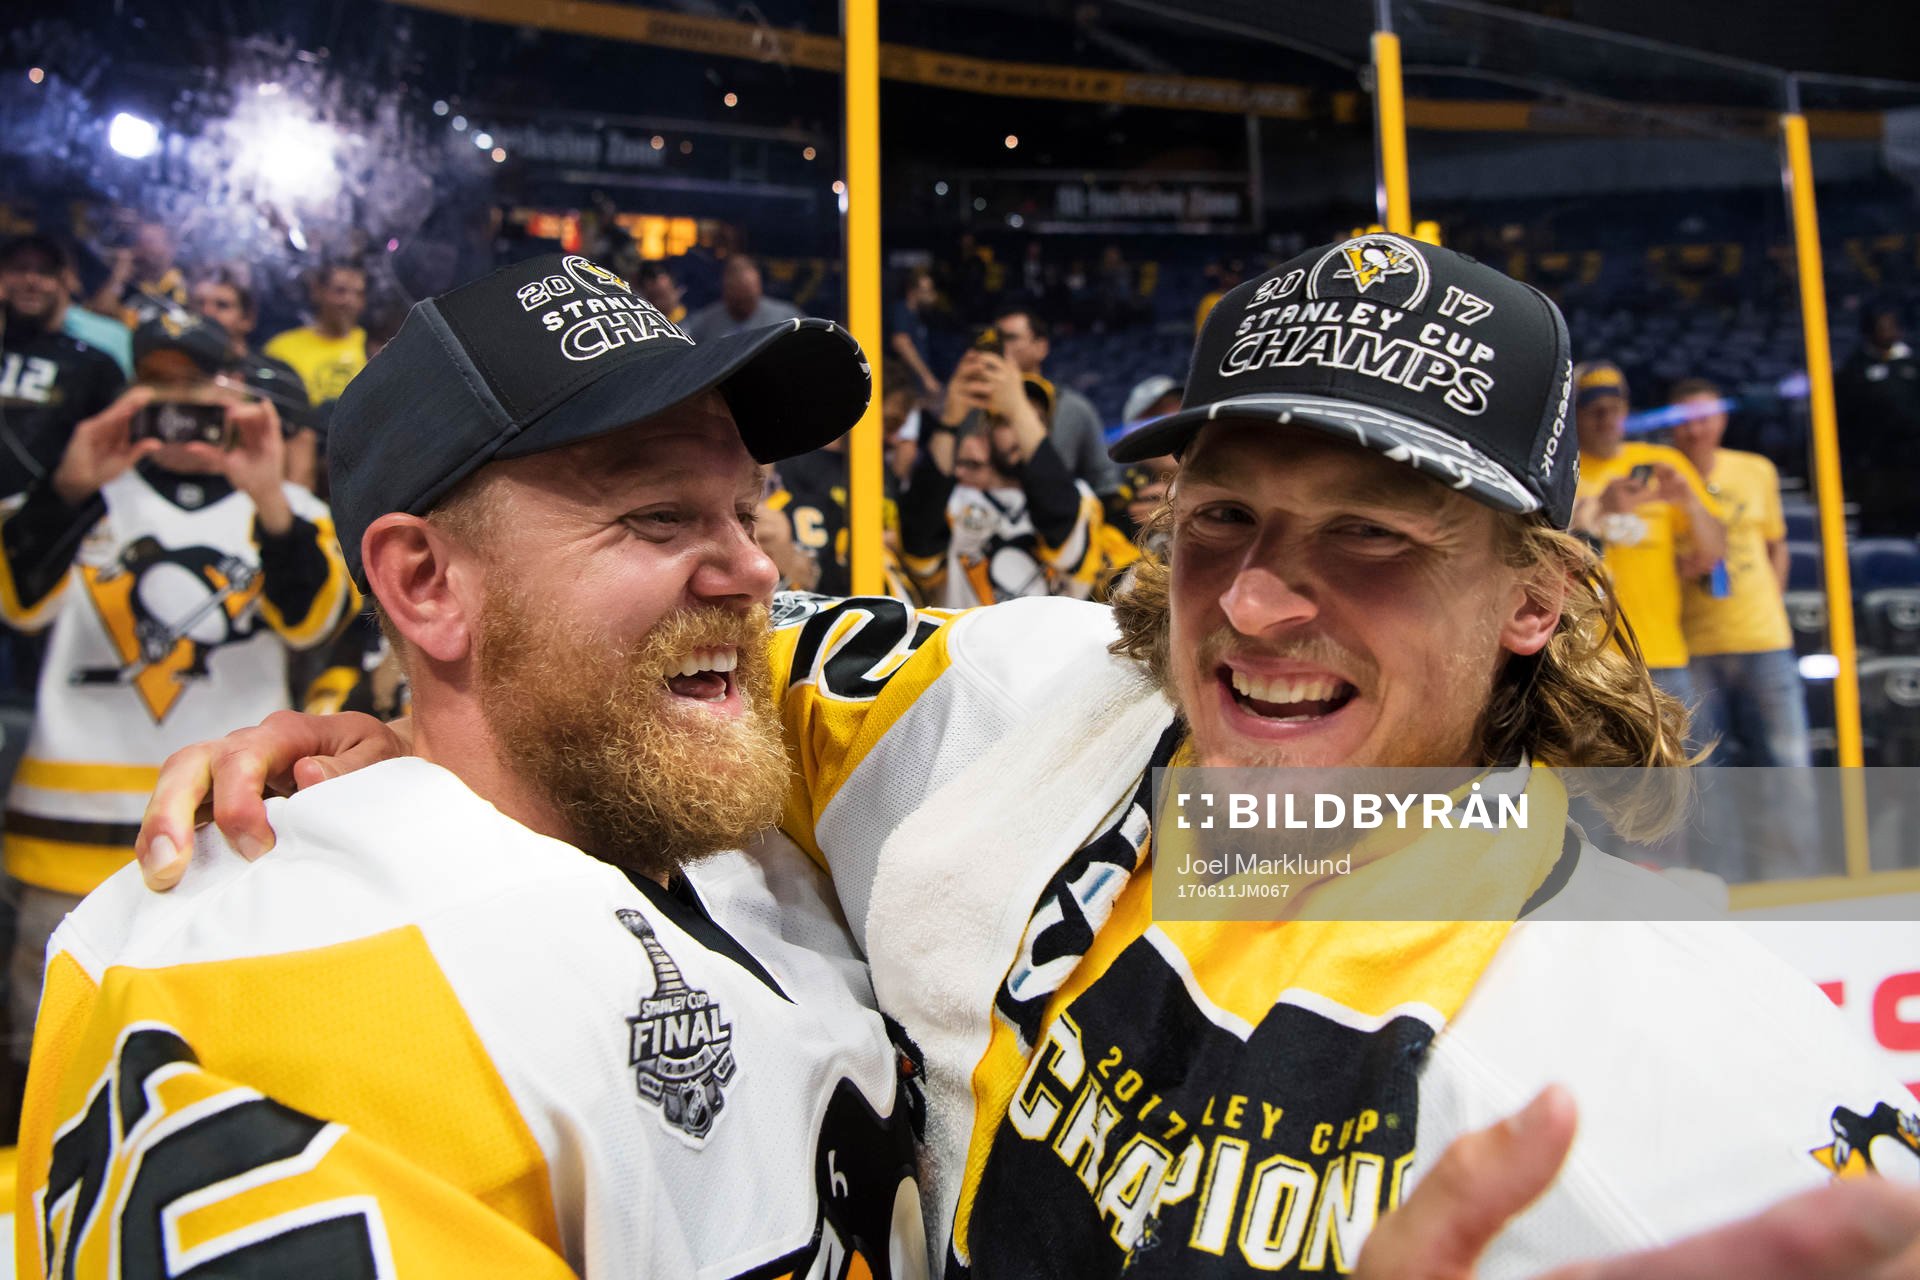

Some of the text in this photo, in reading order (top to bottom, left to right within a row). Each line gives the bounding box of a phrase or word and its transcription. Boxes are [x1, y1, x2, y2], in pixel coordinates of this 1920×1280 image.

[516, 275, 575, 311] 20
[1245, 269, 1494, 326] 20 17
[561, 310, 696, 361] CHA
[1236, 302, 1495, 363] STANLEY CUP
[1219, 325, 1494, 416] CHAMPS
[642, 992, 709, 1019] STANLEY CUP
[633, 1008, 730, 1061] FINAL
[1097, 1046, 1188, 1140] 2017
